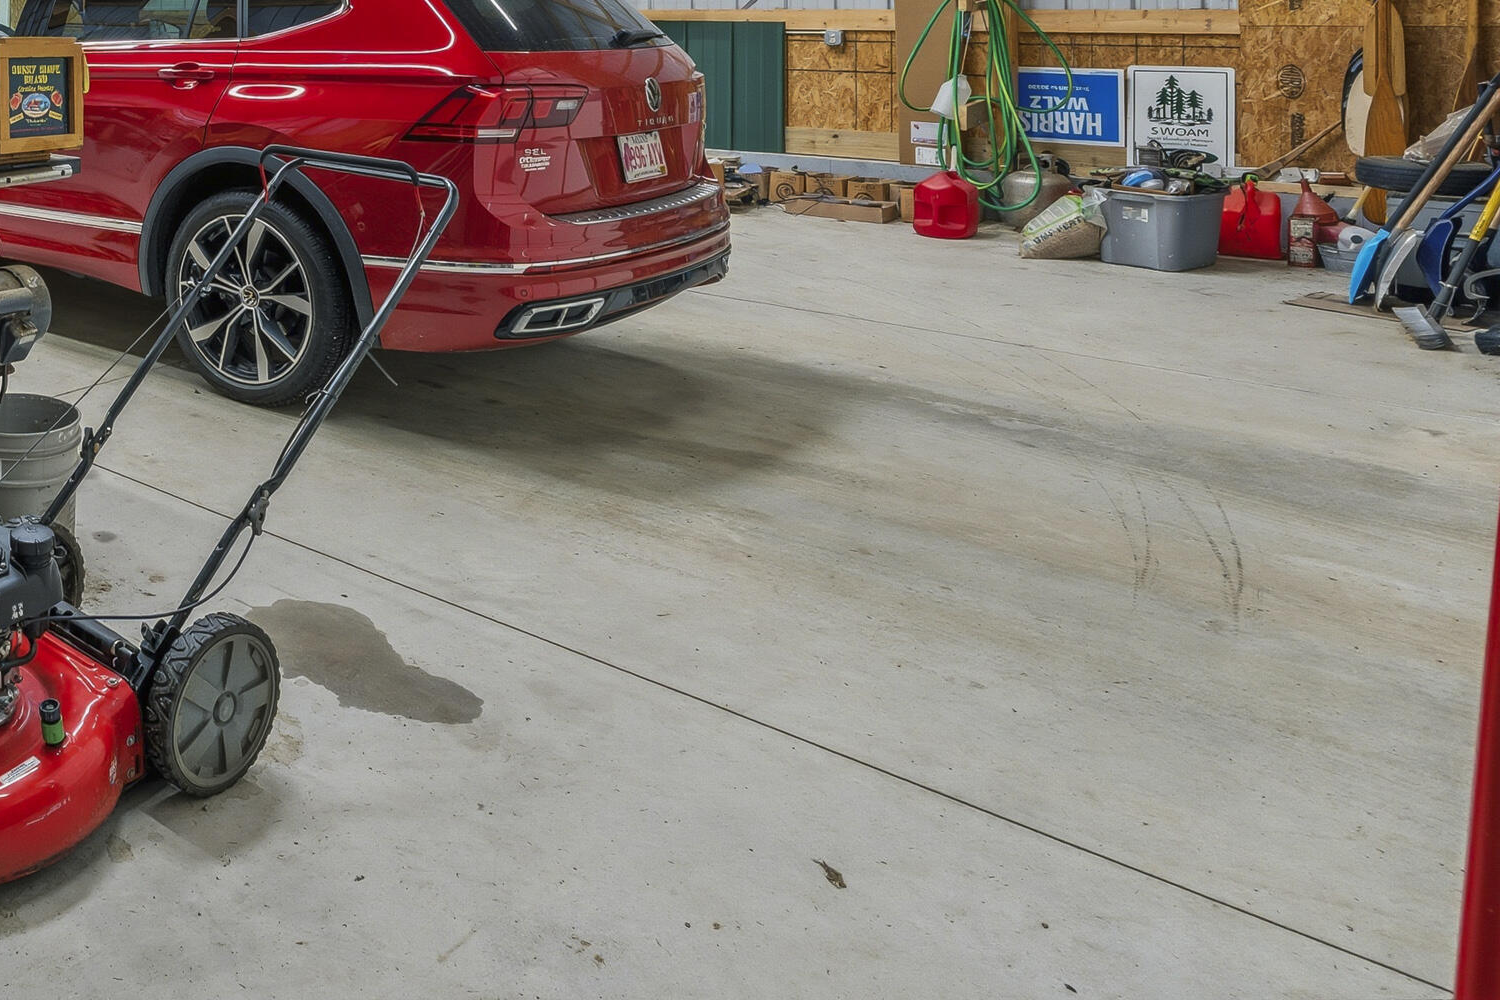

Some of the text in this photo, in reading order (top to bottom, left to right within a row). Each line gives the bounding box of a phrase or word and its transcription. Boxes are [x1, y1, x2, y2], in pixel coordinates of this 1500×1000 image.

[1030, 95, 1089, 111] WALZ
[1018, 110, 1101, 136] HARRIS
[1151, 127, 1209, 137] SWOAM
